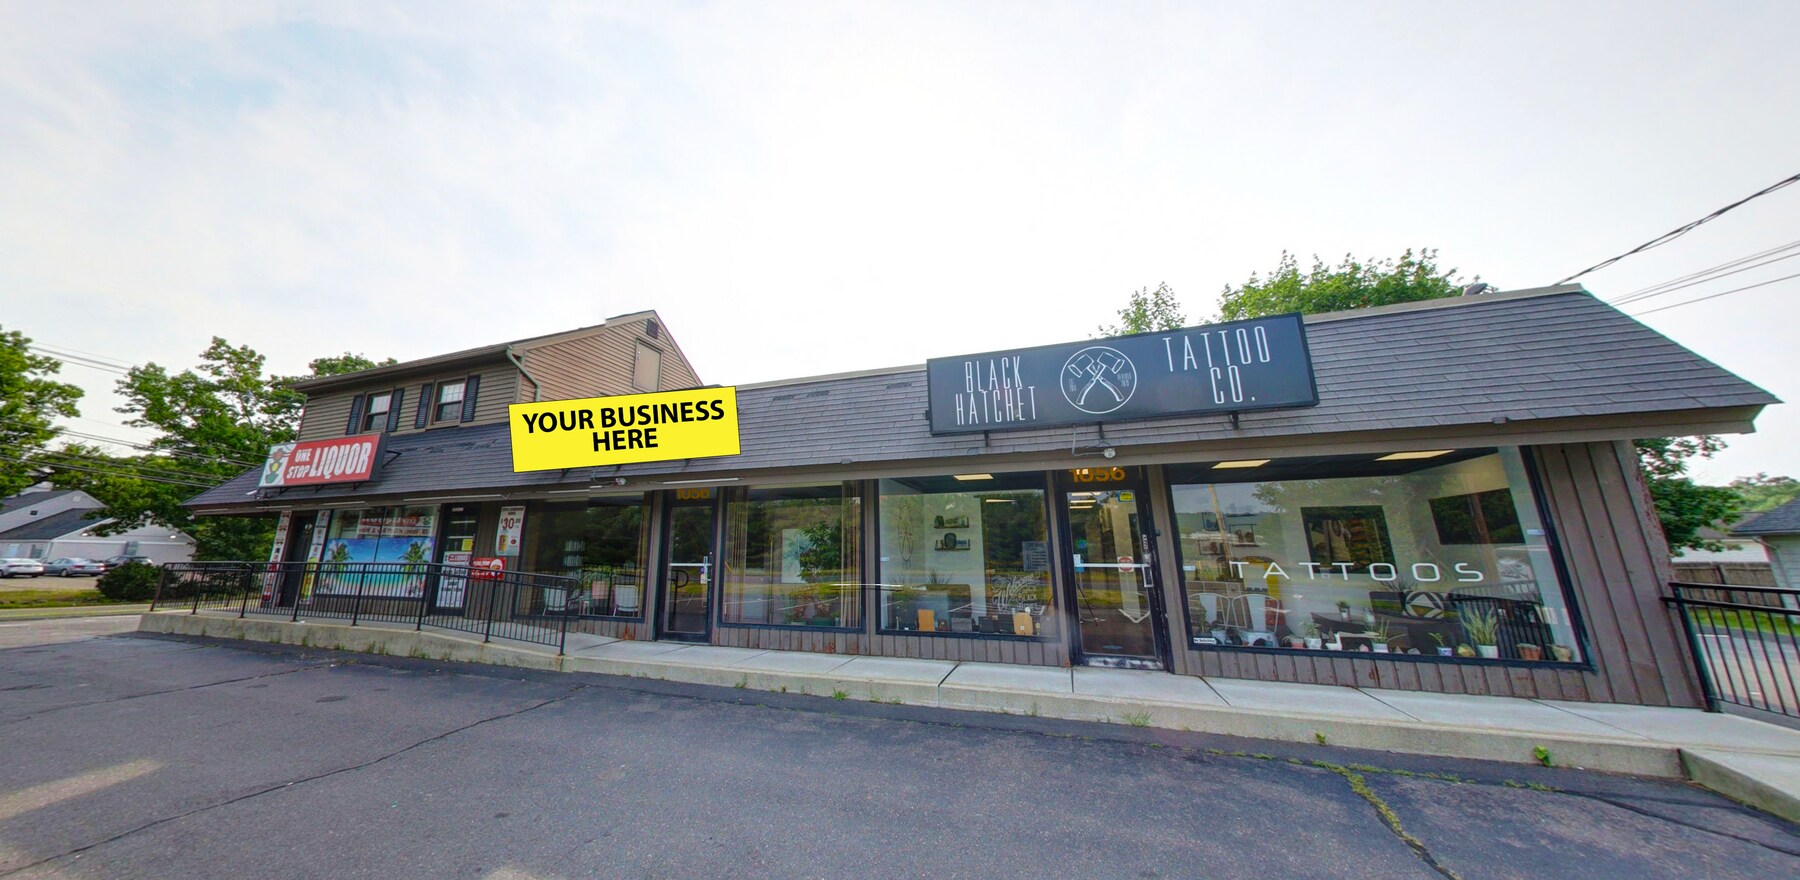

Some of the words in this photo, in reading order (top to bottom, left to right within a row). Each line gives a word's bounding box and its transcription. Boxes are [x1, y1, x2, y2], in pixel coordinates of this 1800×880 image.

[1163, 326, 1271, 372] TATTOO
[965, 355, 1023, 393] BLACK
[1210, 364, 1257, 404] CO.
[956, 386, 1036, 425] HATCHET
[286, 465, 310, 479] STOP
[295, 449, 312, 462] ONE
[309, 442, 372, 479] LIQUOR
[1071, 467, 1126, 483] 1056
[1229, 562, 1485, 582] TATTOOS
